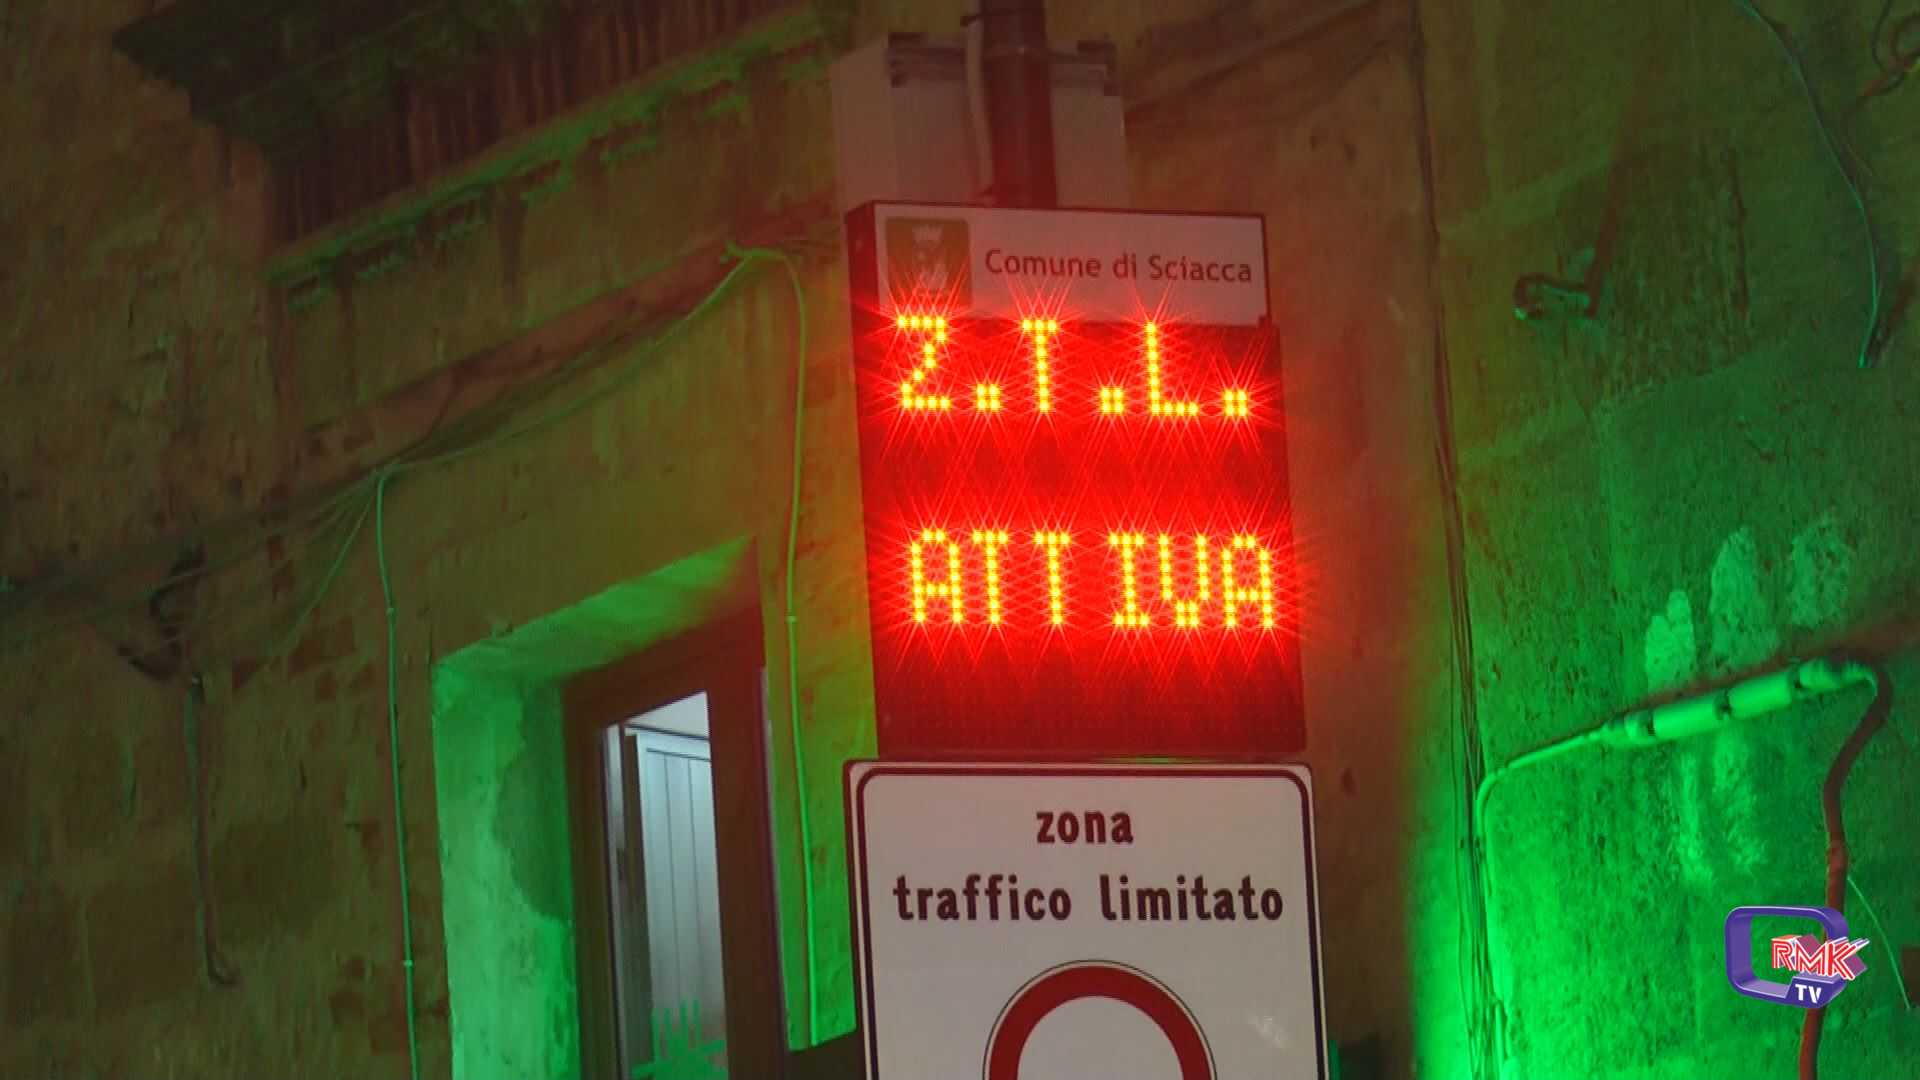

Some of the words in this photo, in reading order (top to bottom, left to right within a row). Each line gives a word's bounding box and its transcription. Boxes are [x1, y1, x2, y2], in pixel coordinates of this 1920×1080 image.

[984, 249, 1101, 279] Comune
[1112, 252, 1138, 280] di
[1148, 254, 1253, 283] Sciacca
[910, 529, 1276, 628] ATTIVA
[1035, 810, 1134, 844] zona
[892, 874, 1073, 922] traffico
[1099, 873, 1284, 922] limitato
